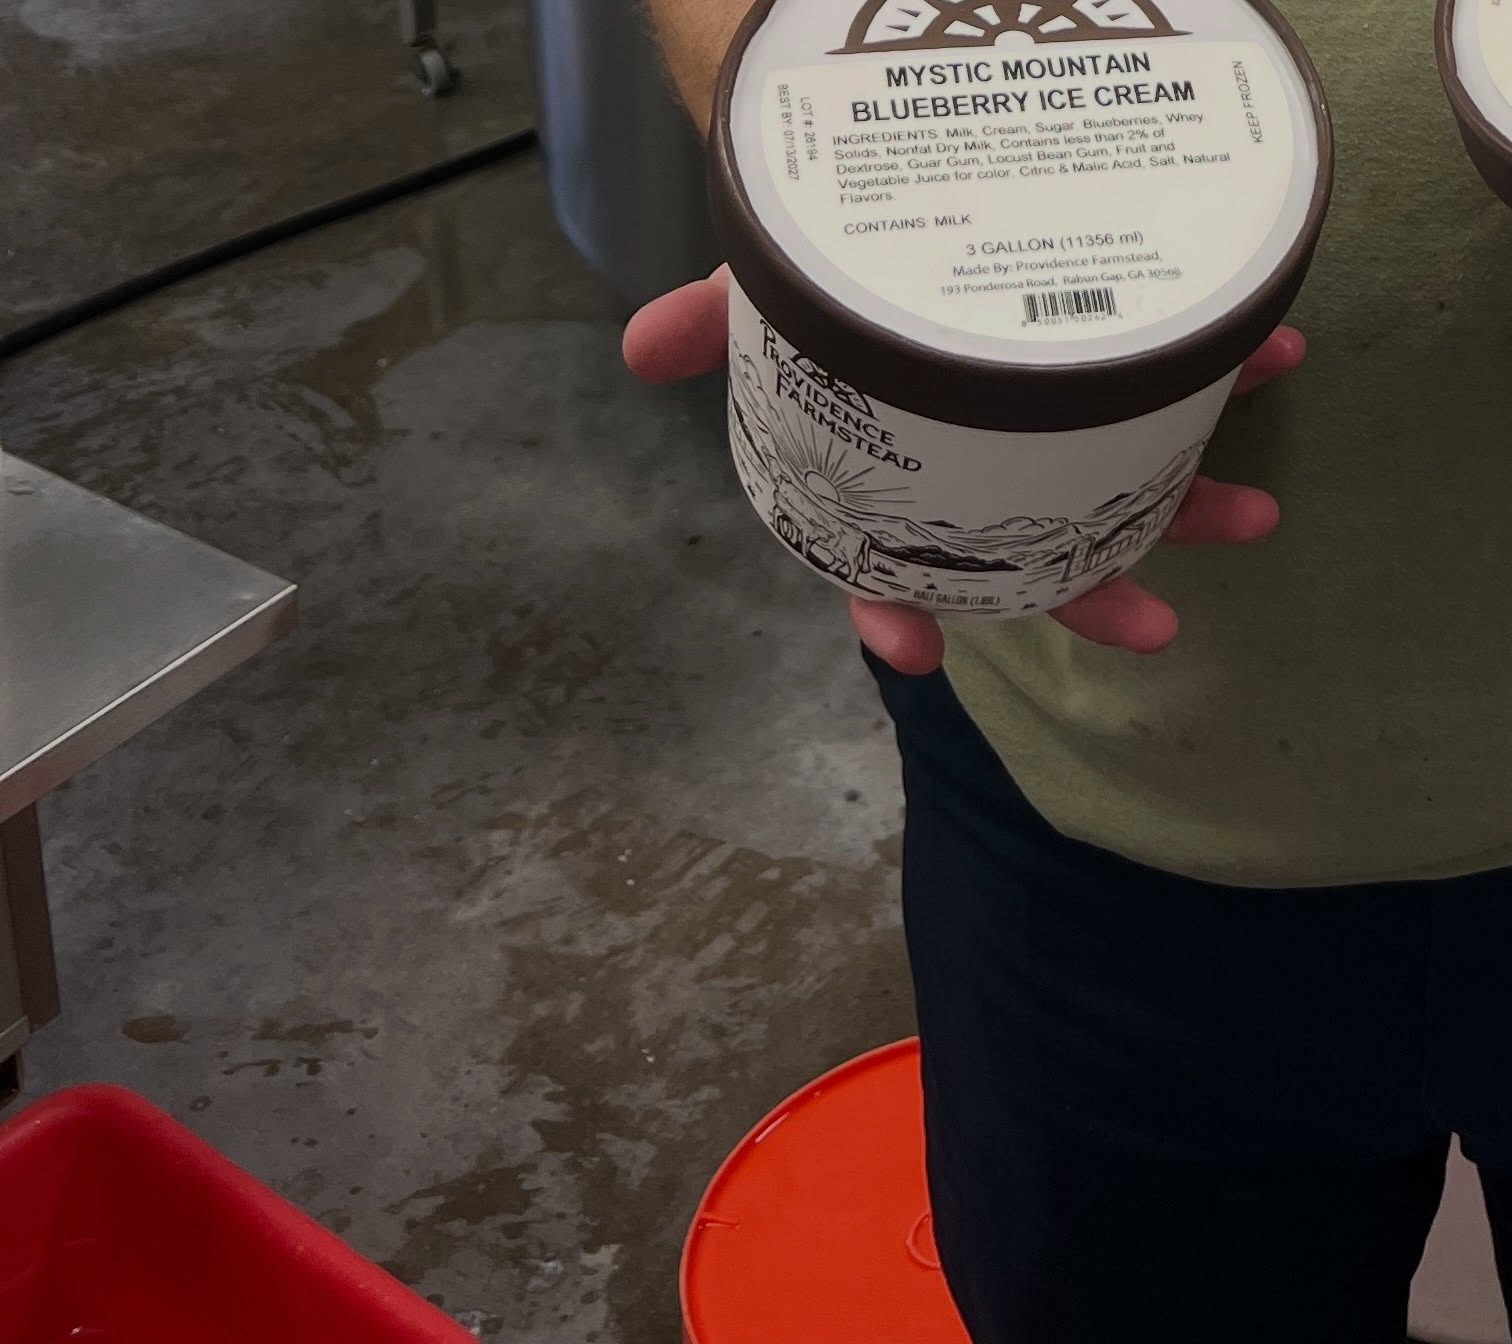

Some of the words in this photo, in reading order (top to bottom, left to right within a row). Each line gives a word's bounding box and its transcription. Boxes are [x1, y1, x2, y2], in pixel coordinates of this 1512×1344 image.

[885, 61, 992, 87] MYSTIC
[1001, 51, 1150, 80] MOUNTAIN
[1232, 60, 1255, 108] FROZEN
[800, 96, 813, 117] LOT
[851, 90, 1027, 122] BLUEBERRY
[1038, 87, 1086, 110] ICE
[1093, 80, 1195, 106] CREAM
[1082, 116, 1161, 129] Blueberries,
[1165, 112, 1203, 123] Whey
[1246, 112, 1264, 143] KEEP
[885, 143, 931, 156] Nonfat
[935, 142, 959, 153] Dry
[999, 137, 1060, 149] Contains
[1063, 135, 1091, 144] less
[1093, 132, 1124, 142] than
[1127, 129, 1149, 140] 2%
[1152, 127, 1164, 138] of
[907, 158, 941, 169] Guar
[987, 151, 1033, 164] Locust
[1036, 150, 1072, 161] Bean
[1115, 143, 1146, 155] Fruit
[1150, 141, 1175, 152] and
[837, 174, 909, 189] Vegetable
[913, 173, 950, 184] Juice
[953, 170, 972, 181] for
[1018, 165, 1054, 176] Citric
[1058, 162, 1068, 173] &
[1071, 161, 1108, 173] Malic
[1182, 152, 1230, 164] Natural
[934, 213, 971, 226] MILK
[965, 243, 976, 256] 3
[981, 237, 1054, 254] GALLON
[1059, 233, 1114, 251] (11356
[1119, 231, 1143, 246] ml)
[952, 263, 990, 277] Made
[993, 262, 1013, 275] By:
[1015, 257, 1088, 271] Providence
[1091, 249, 1162, 265] Farmstead,
[940, 284, 960, 296] 193
[963, 281, 1024, 293] Ponderosa
[1062, 273, 1098, 285] Rabun
[1127, 269, 1145, 279] GA
[760, 318, 896, 447] PROVIDENCE
[776, 367, 922, 472] FARMSTEAD
